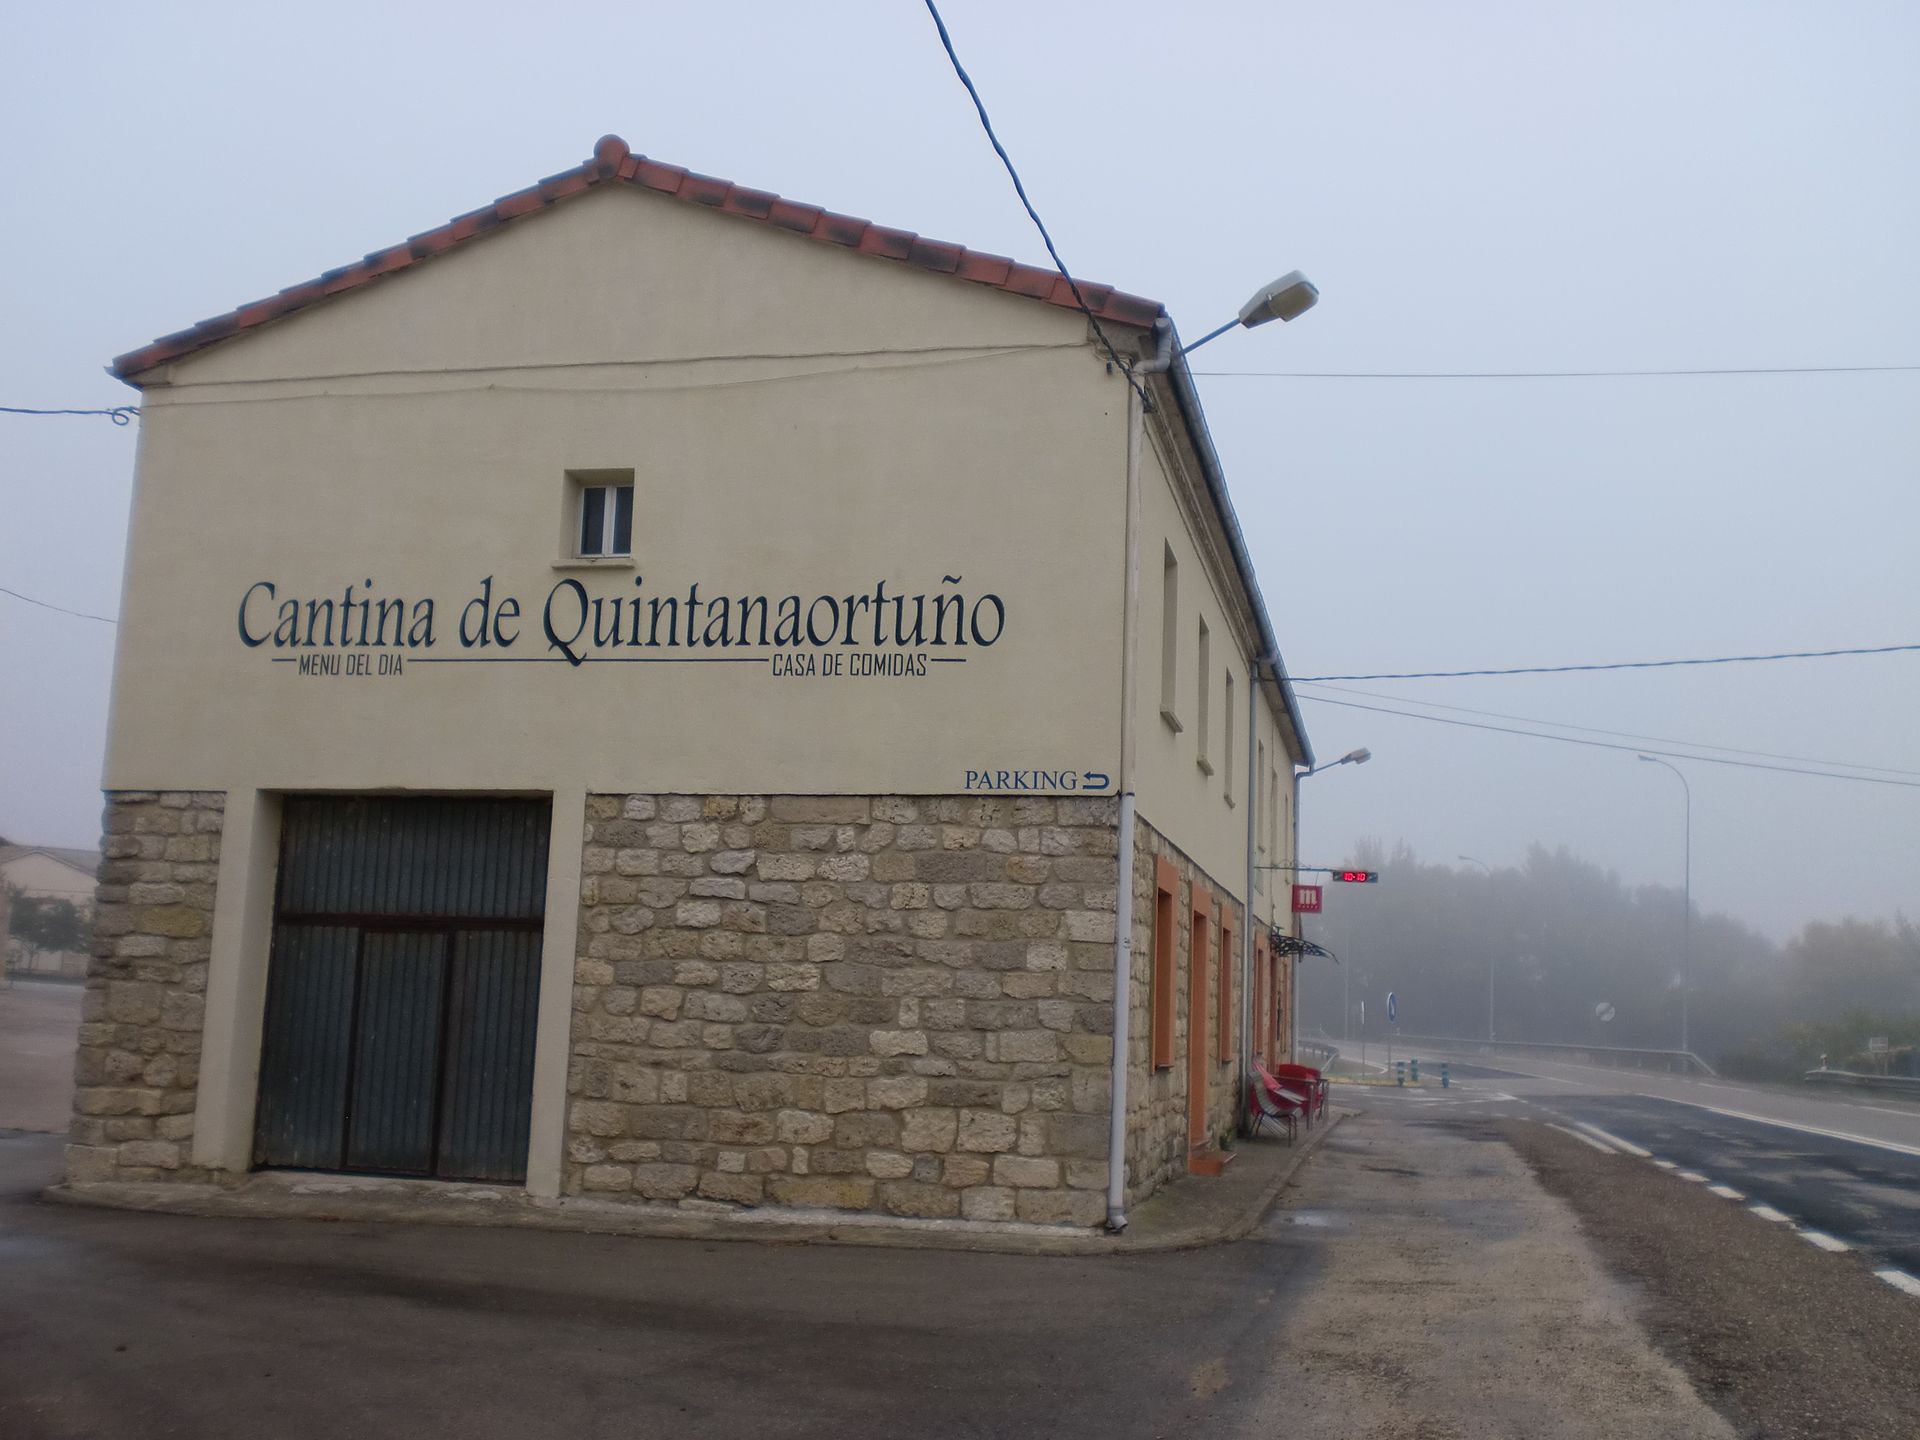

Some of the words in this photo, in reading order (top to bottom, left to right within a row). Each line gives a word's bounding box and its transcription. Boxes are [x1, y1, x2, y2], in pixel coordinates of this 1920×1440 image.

[237, 577, 437, 649] Cantina
[458, 574, 521, 649] de
[542, 573, 1006, 668] Quintanaortuño
[298, 653, 341, 676] MENU
[345, 653, 372, 676] DEL
[377, 653, 403, 676] DIA
[772, 652, 816, 677] CASA
[822, 652, 844, 677] DE
[849, 652, 927, 677] COMIDAS
[963, 769, 1078, 791] PARKING
